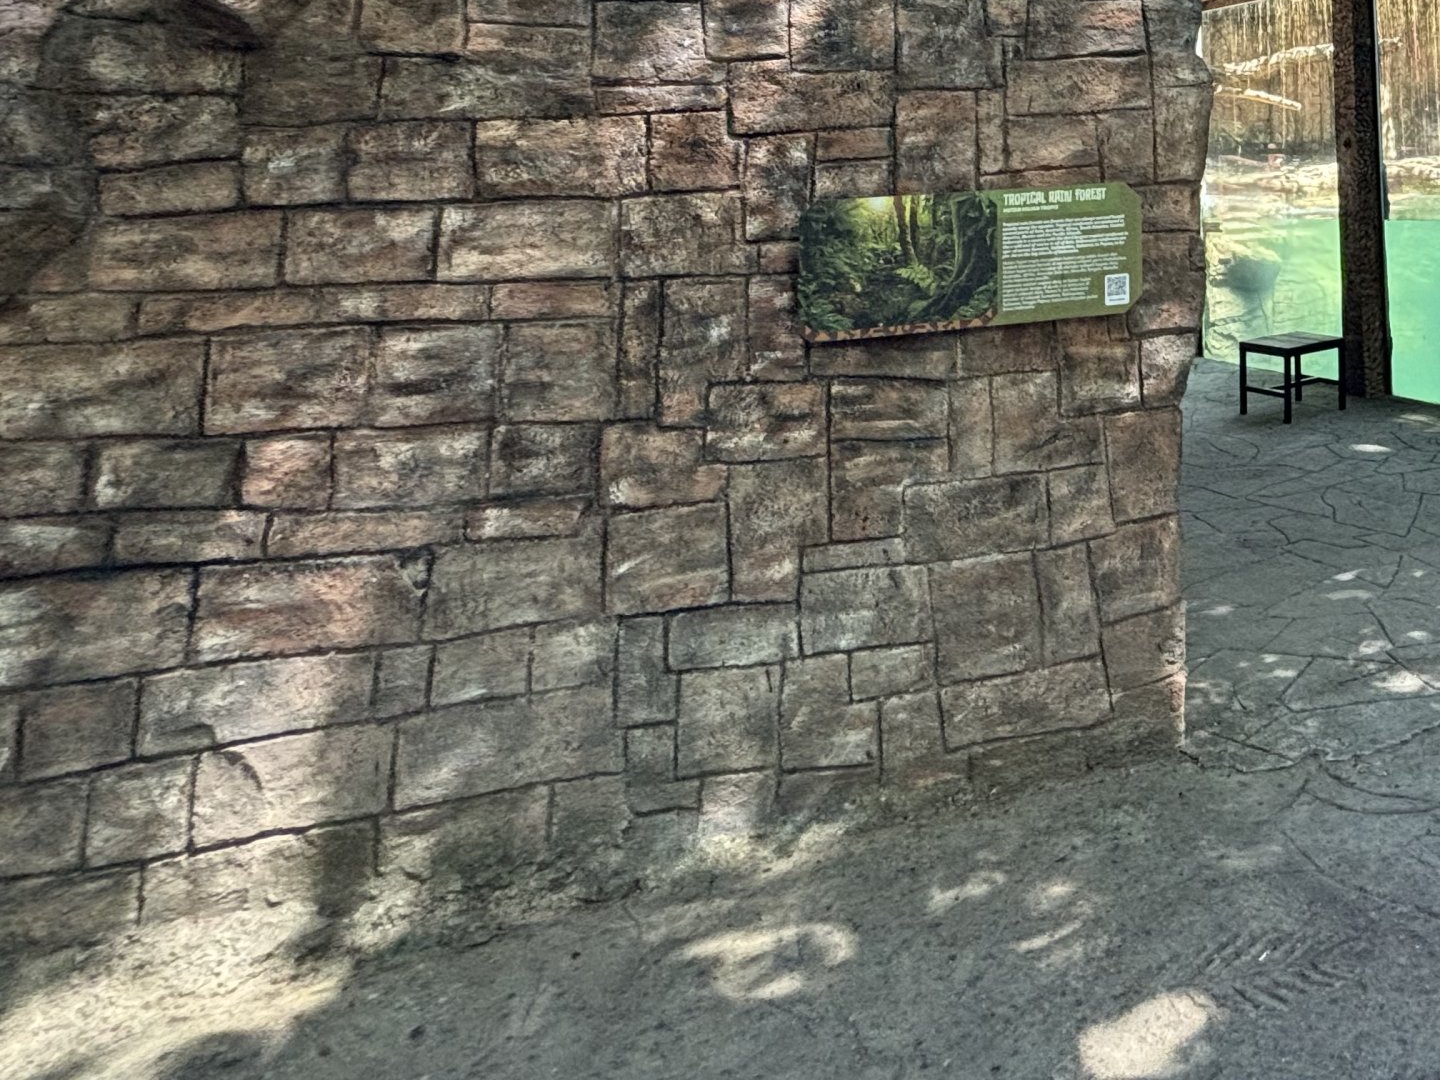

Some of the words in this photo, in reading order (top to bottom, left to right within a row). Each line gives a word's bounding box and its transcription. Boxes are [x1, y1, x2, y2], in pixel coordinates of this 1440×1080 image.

[1003, 191, 1046, 206] TROPICAL
[1048, 189, 1073, 203] RAIN
[1075, 187, 1106, 201] FOREST
